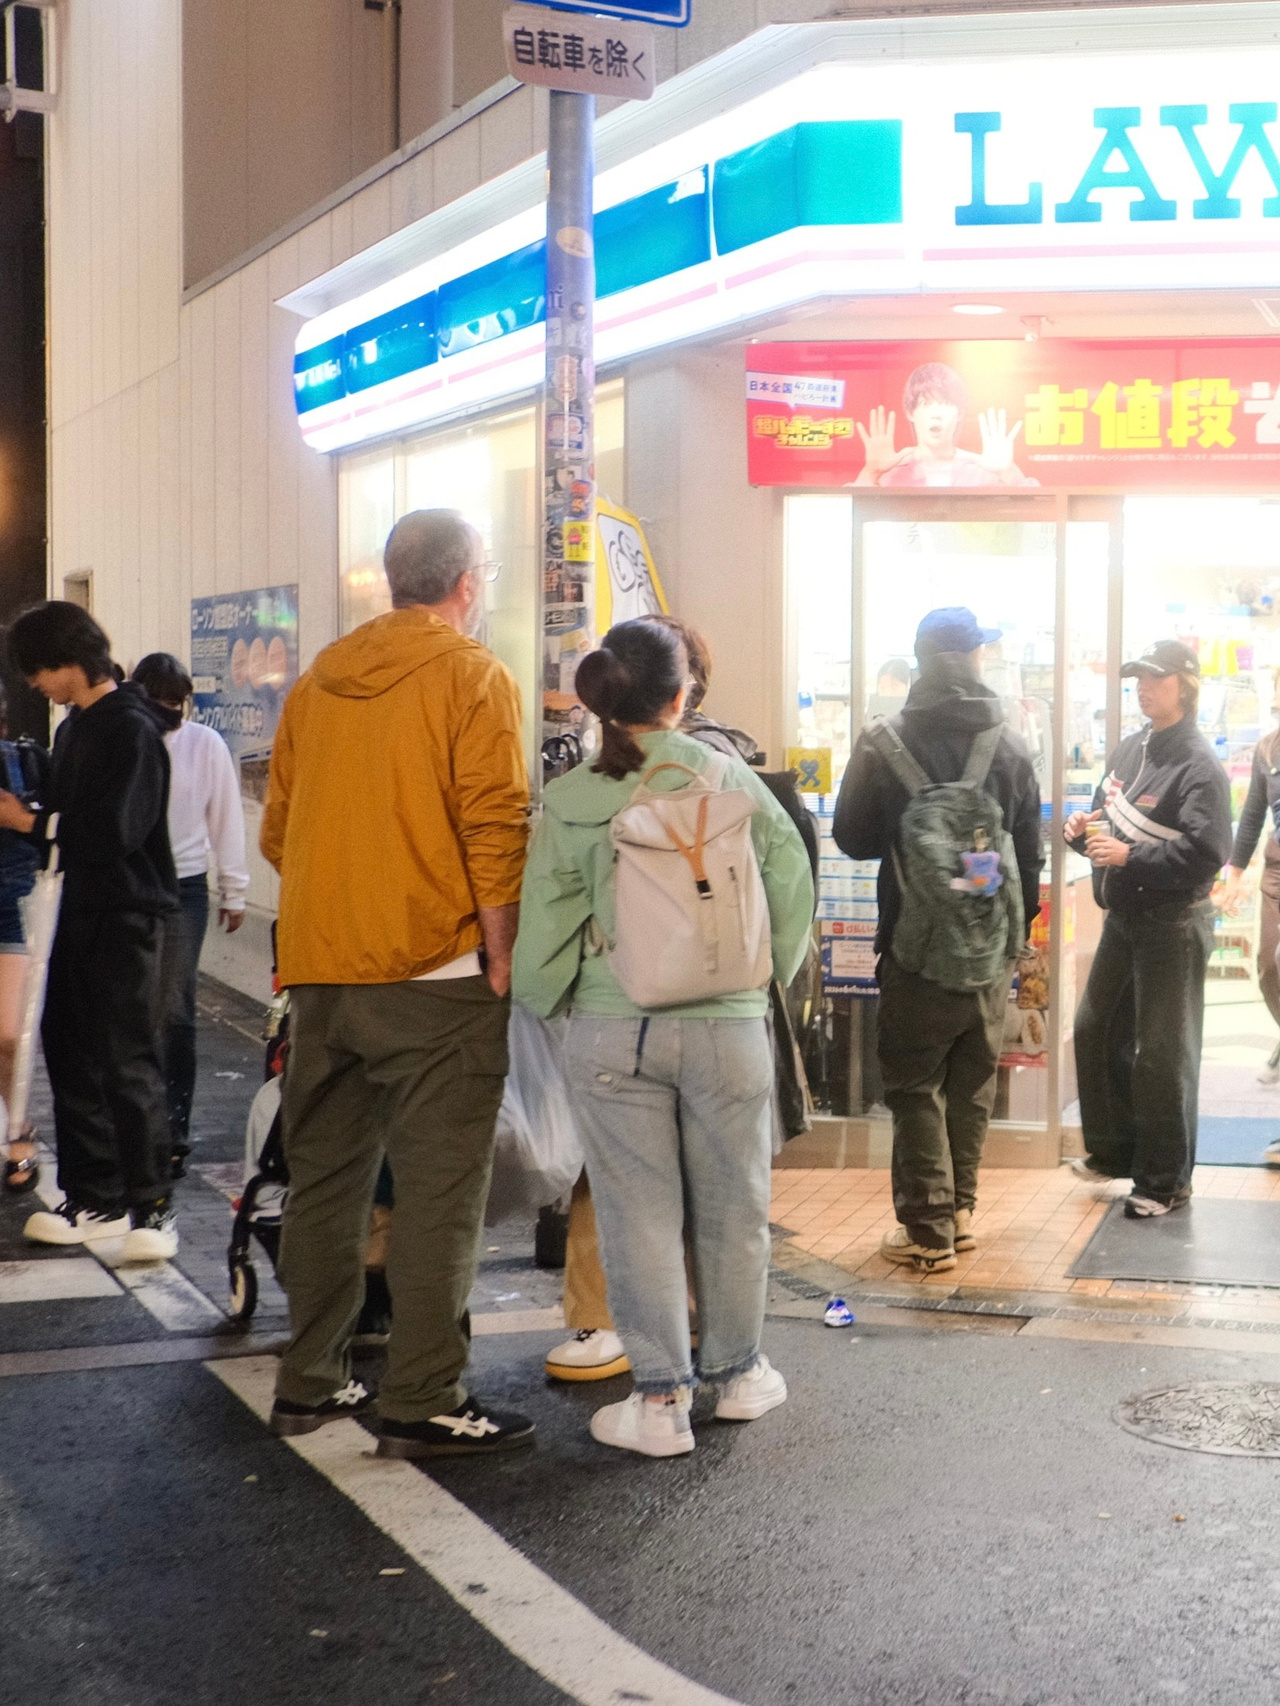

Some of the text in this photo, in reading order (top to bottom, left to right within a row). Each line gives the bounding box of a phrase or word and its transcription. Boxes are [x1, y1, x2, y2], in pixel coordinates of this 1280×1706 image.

[513, 26, 646, 80] 自転車を除く
[749, 380, 793, 394] 日本全国
